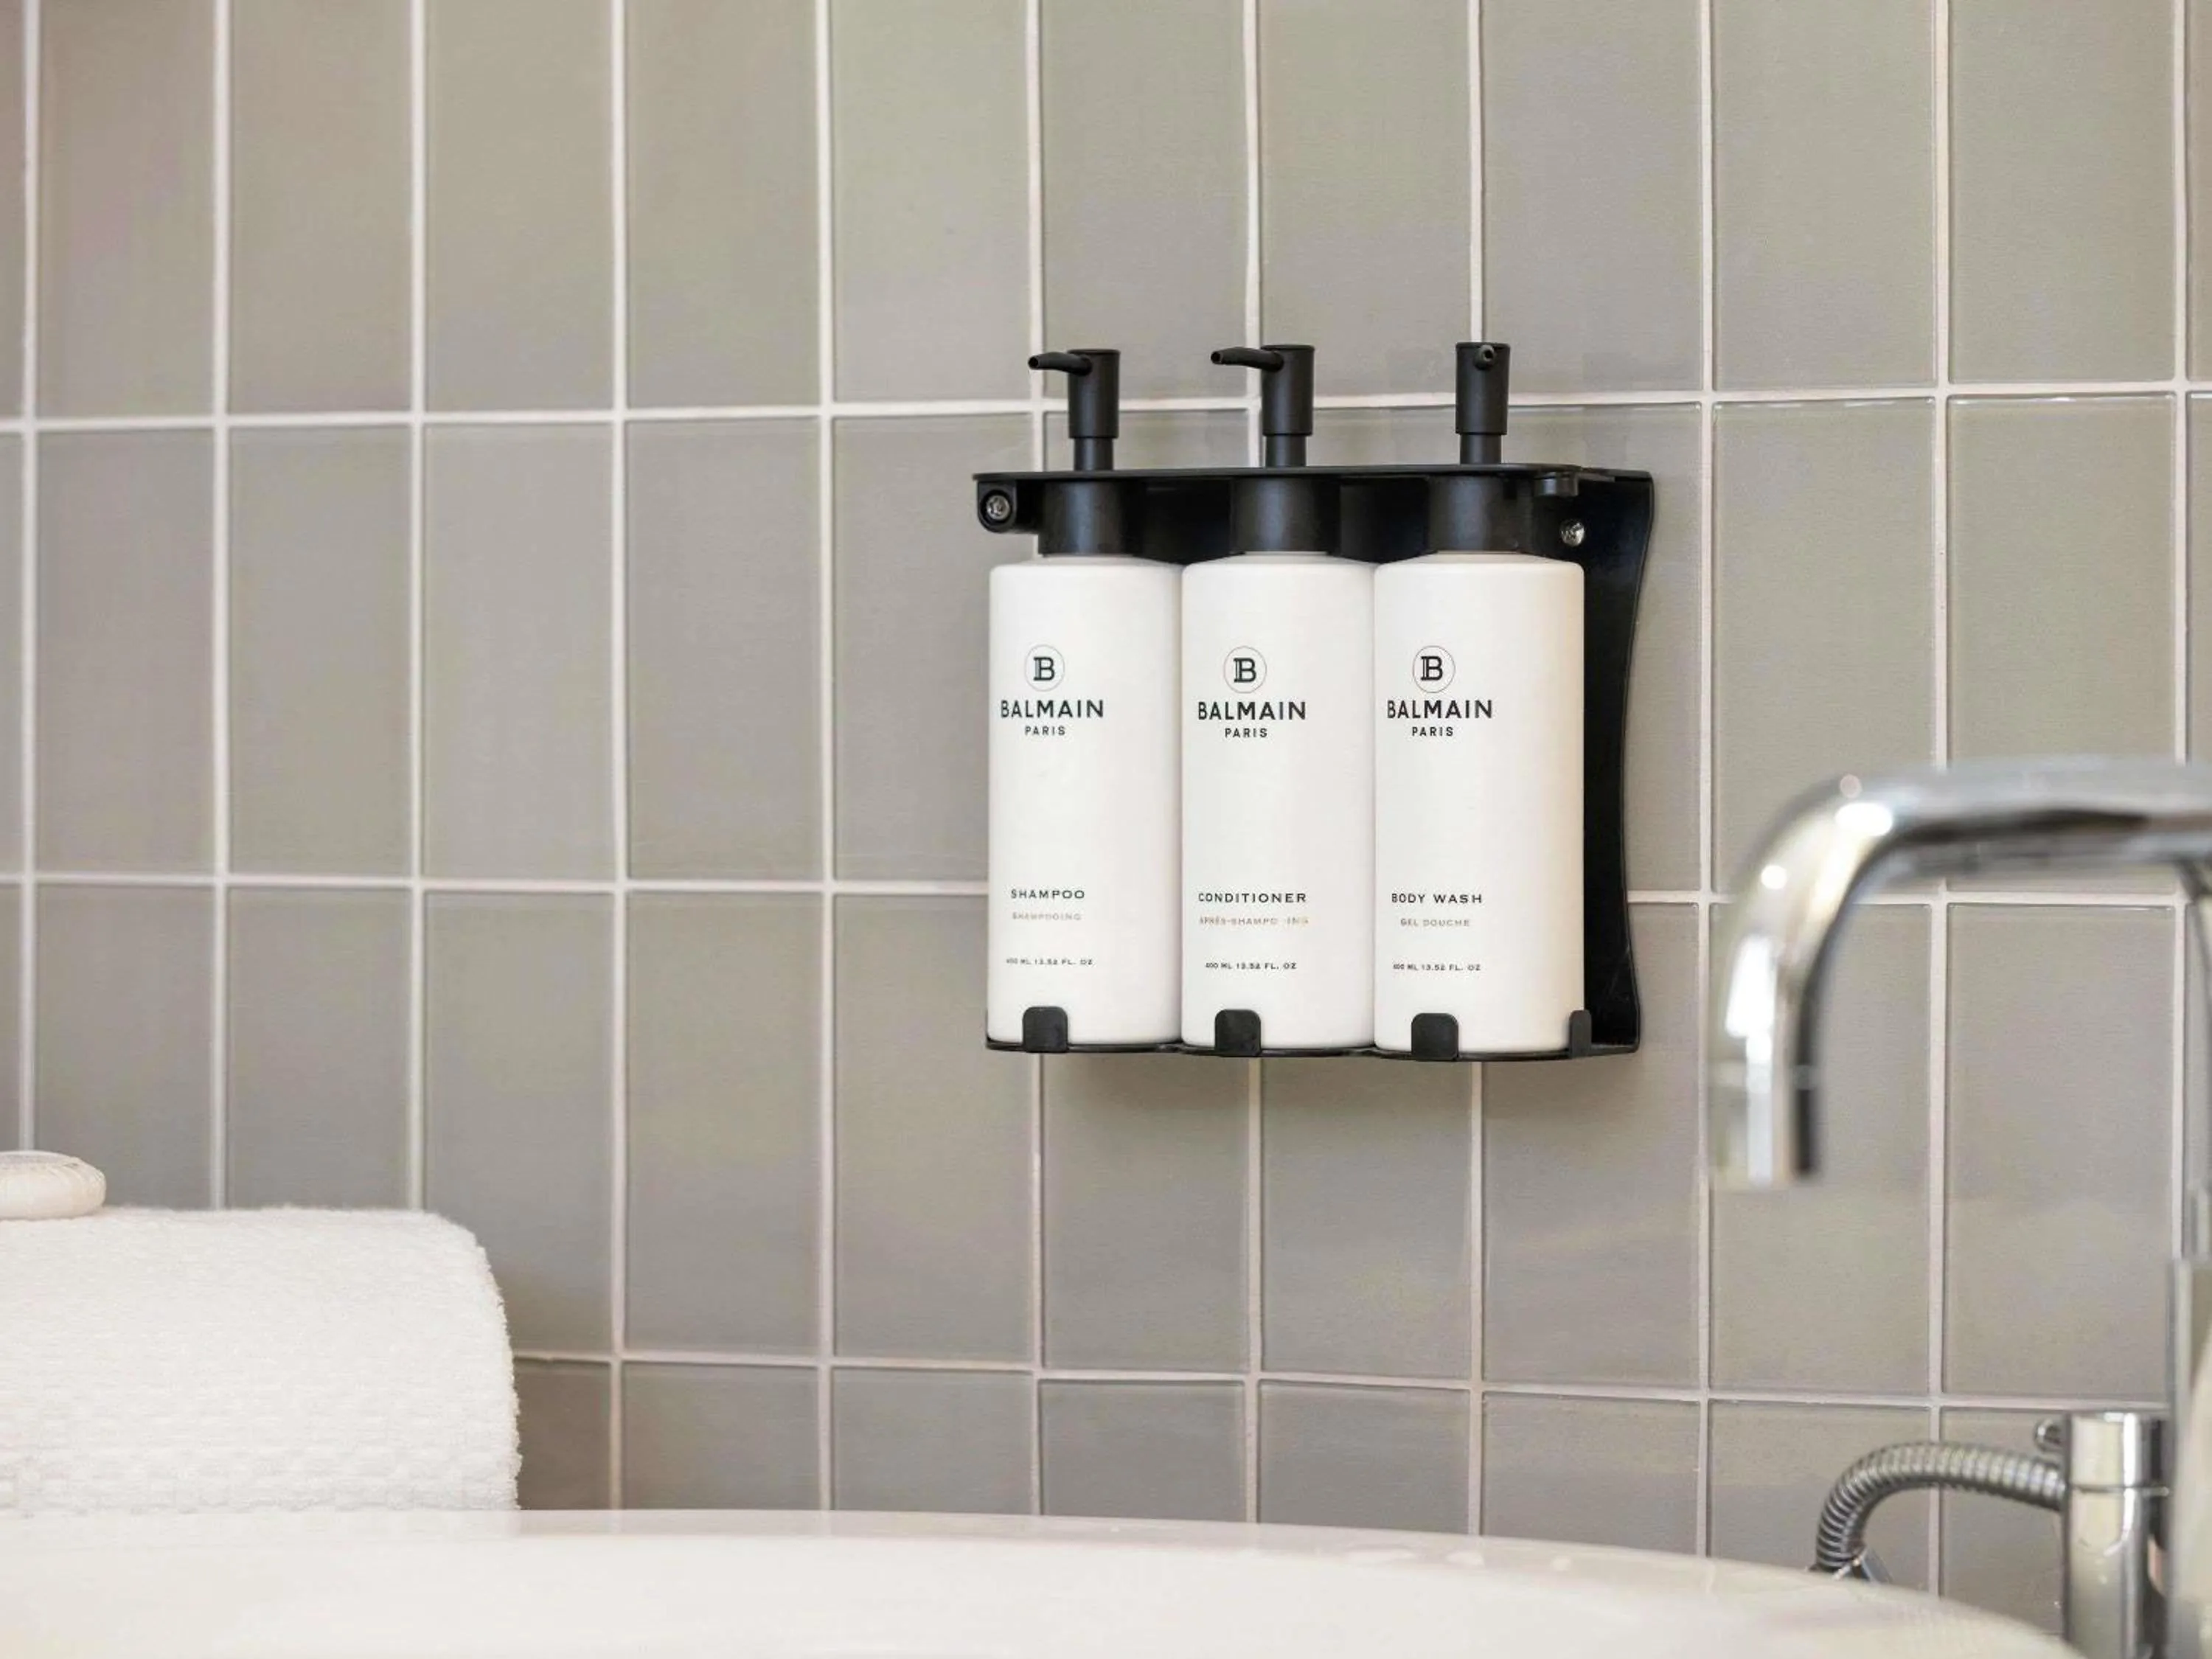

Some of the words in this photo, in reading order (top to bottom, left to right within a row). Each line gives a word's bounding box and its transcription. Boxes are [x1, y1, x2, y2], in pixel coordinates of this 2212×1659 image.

[1033, 655, 1056, 682] B
[1233, 657, 1257, 684] B
[1419, 655, 1444, 681] B
[1001, 699, 1104, 718] BALMAIN
[1197, 701, 1306, 720] BALMAIN
[1387, 699, 1492, 719] BALMAIN
[1024, 725, 1066, 736] PARIS
[1225, 727, 1268, 738] PARIS
[1411, 726, 1454, 737] PARIS
[1011, 888, 1085, 900] SHAMPOO
[1198, 892, 1307, 903] CONDITIONER
[1391, 893, 1425, 904] BODY
[1433, 893, 1482, 904] WASH
[1400, 917, 1419, 927] GEL
[1422, 918, 1470, 927] DOUCHE
[1079, 958, 1093, 966] OZ
